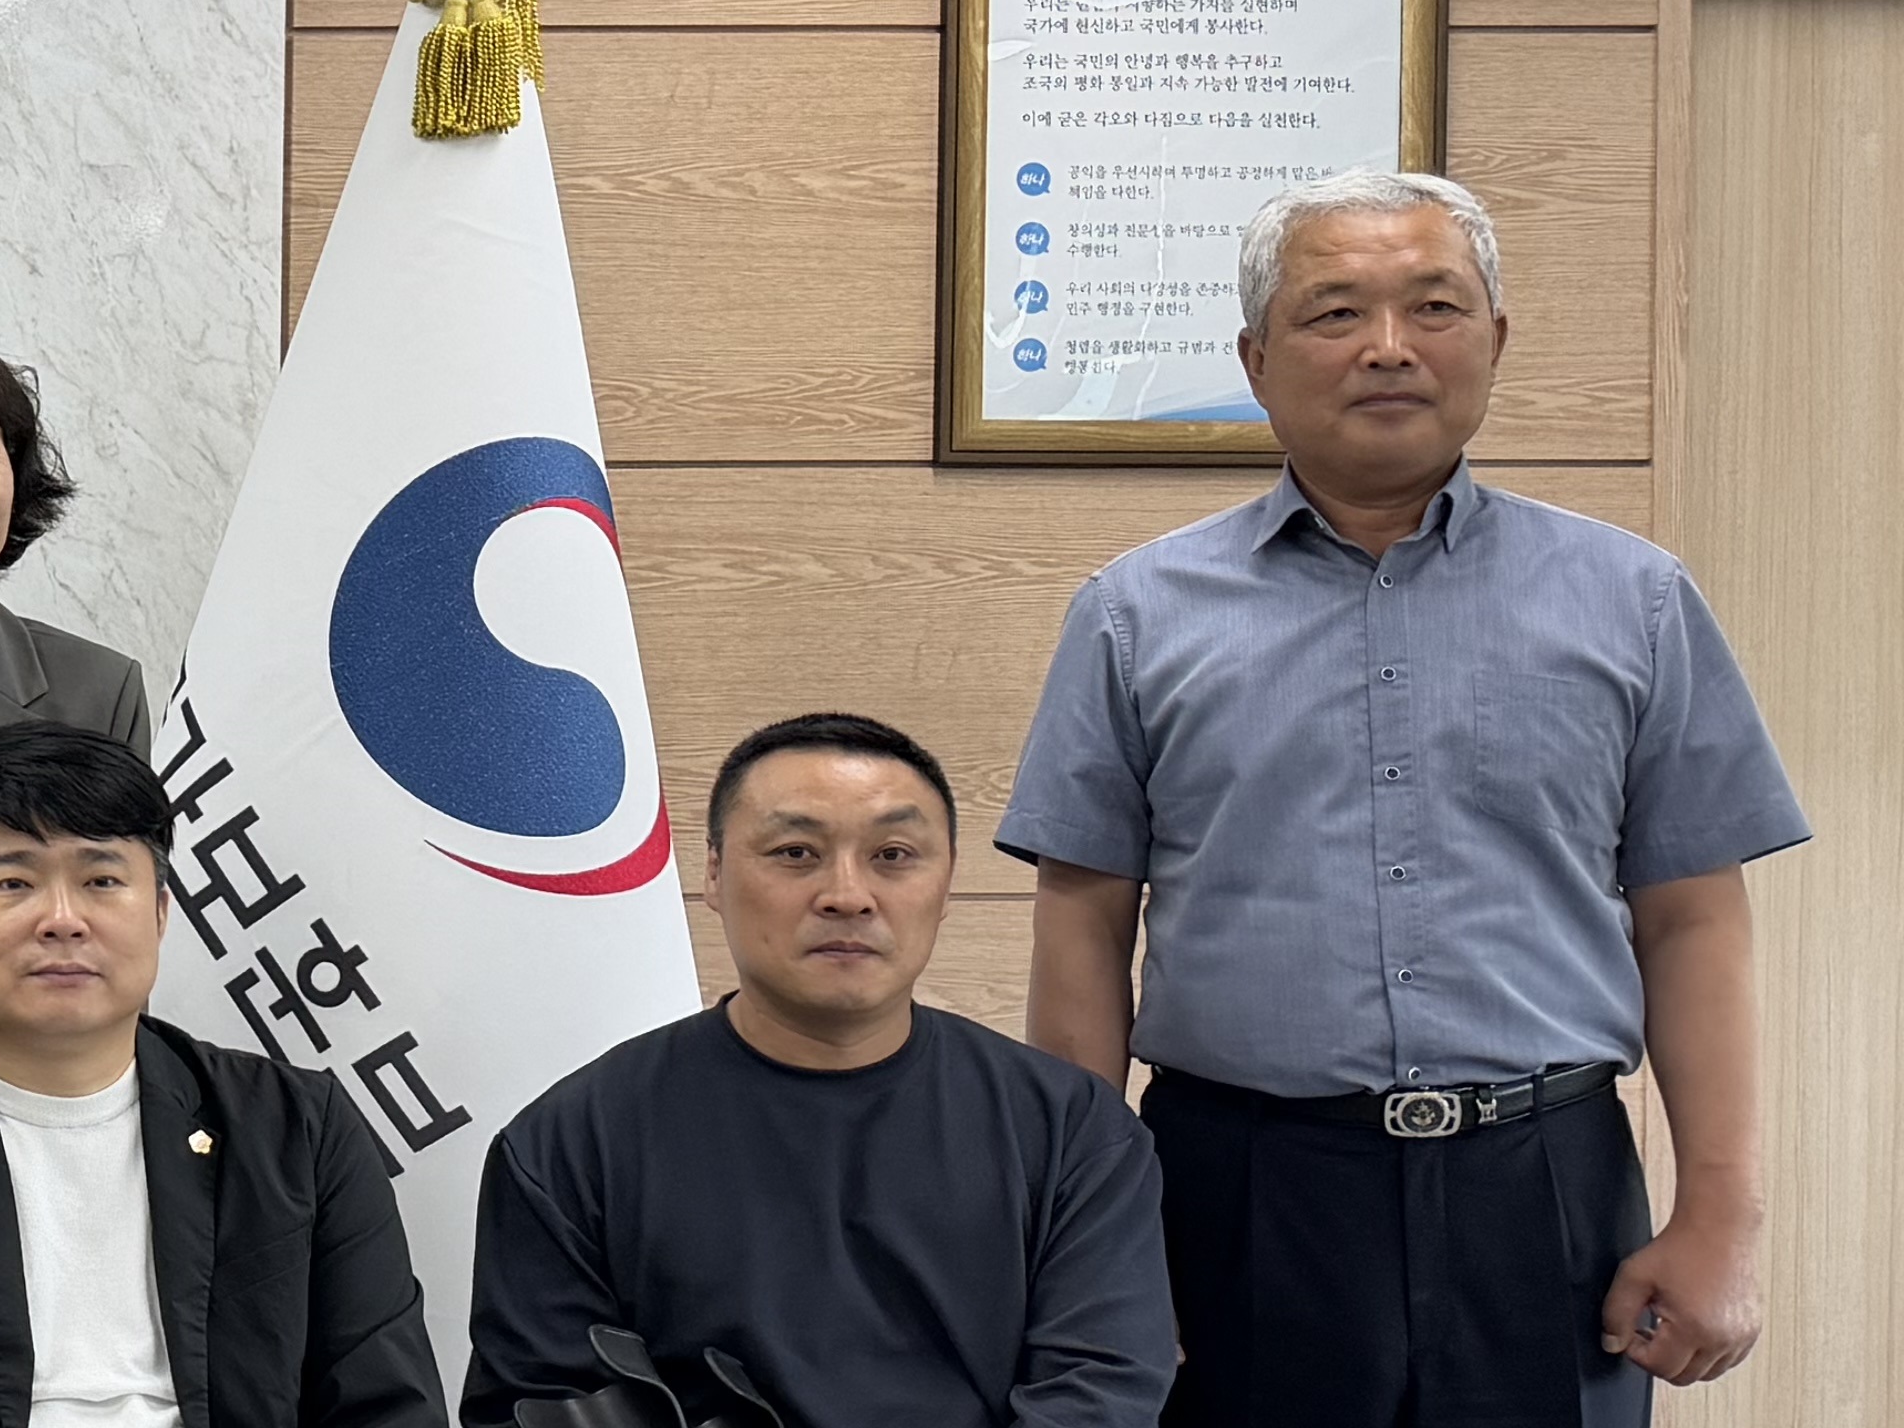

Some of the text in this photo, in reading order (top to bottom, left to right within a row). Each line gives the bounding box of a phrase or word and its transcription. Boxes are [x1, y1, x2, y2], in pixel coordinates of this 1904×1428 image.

[1023, 16, 1268, 35] 국가에 헌신하고 국민에게 봉사한다.
[1022, 52, 1283, 71] 우리는 국민의 안녕과 행복을 추구하고
[1022, 74, 1355, 94] 조국의 평화 통일과 지속 가능한 발전에 기여한다.
[1022, 109, 1321, 129] 이에 굳은 각오와 다짐으로 다음을 실천한다.
[1020, 173, 1045, 187] 하나
[1181, 165, 1232, 180] 투명하고
[1236, 165, 1287, 181] 공정하게
[1068, 184, 1154, 200] 책임을 다한다.
[1067, 222, 1119, 238] 창의성과
[1019, 232, 1044, 246] 하나
[1065, 281, 1092, 296] 우리
[1096, 281, 1135, 297] 사회의
[1195, 282, 1239, 297] 존중하
[1066, 301, 1092, 316] 민주
[158, 649, 473, 1180] 가보훈부
